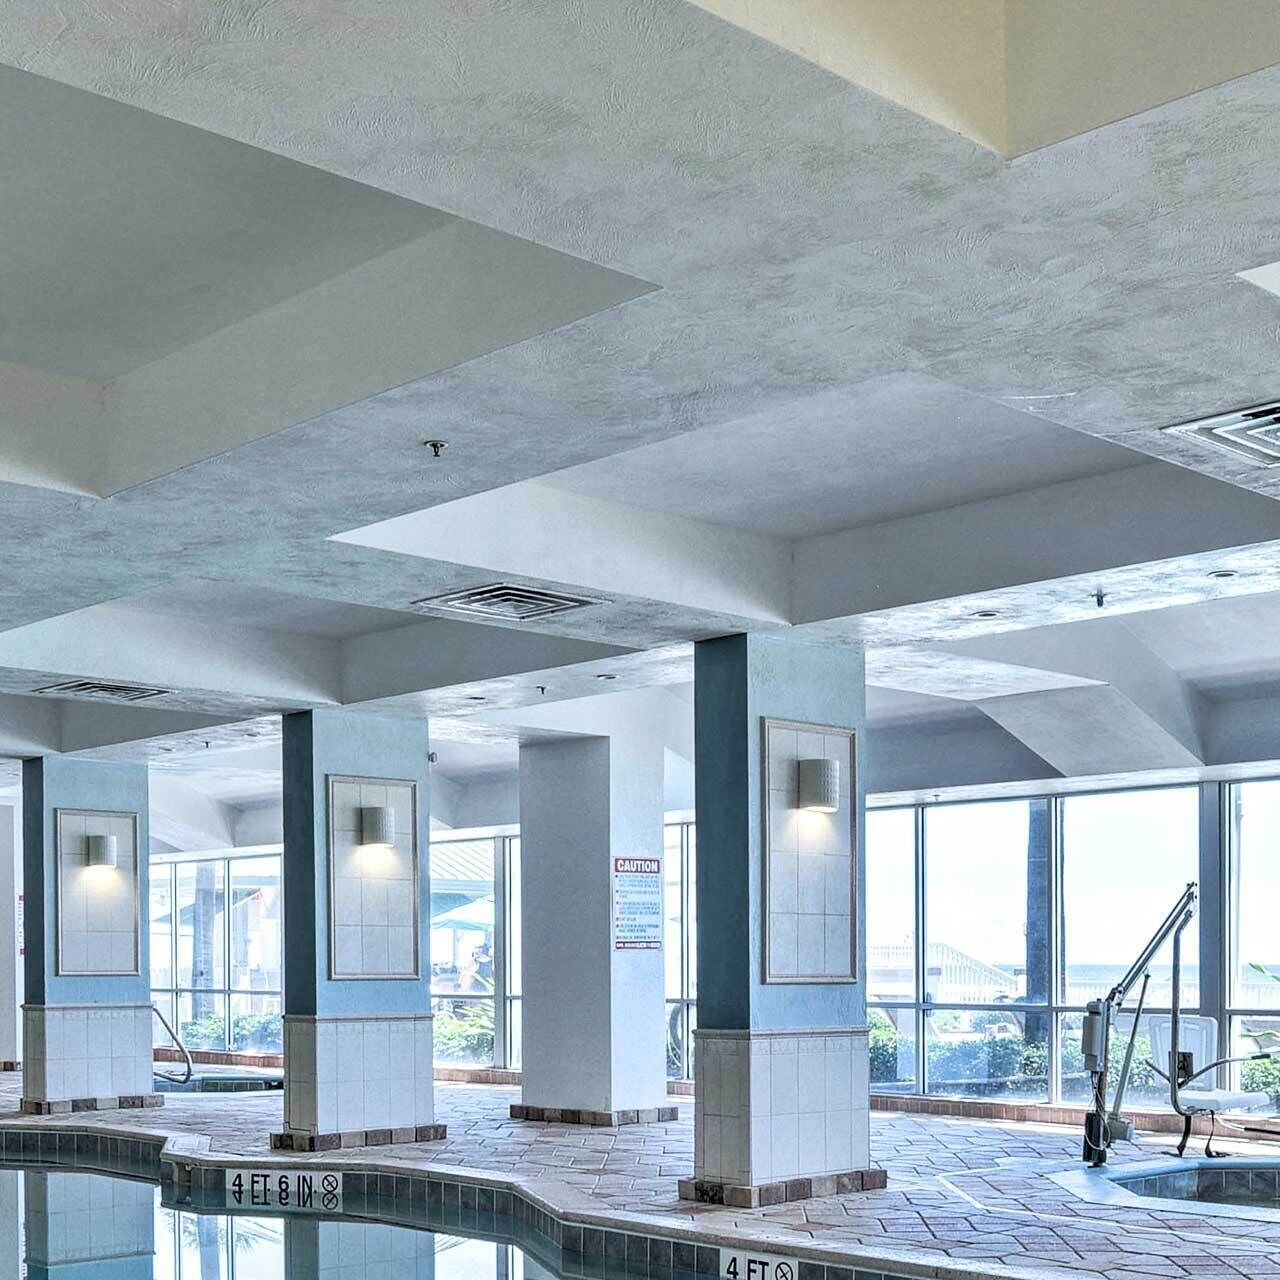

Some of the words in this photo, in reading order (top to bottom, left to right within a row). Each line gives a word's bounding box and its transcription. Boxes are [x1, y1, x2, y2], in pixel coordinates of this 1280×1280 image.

[616, 859, 659, 873] CAUTION
[232, 1173, 244, 1190] 4
[279, 1175, 290, 1192] 6
[726, 1256, 739, 1279] 4
